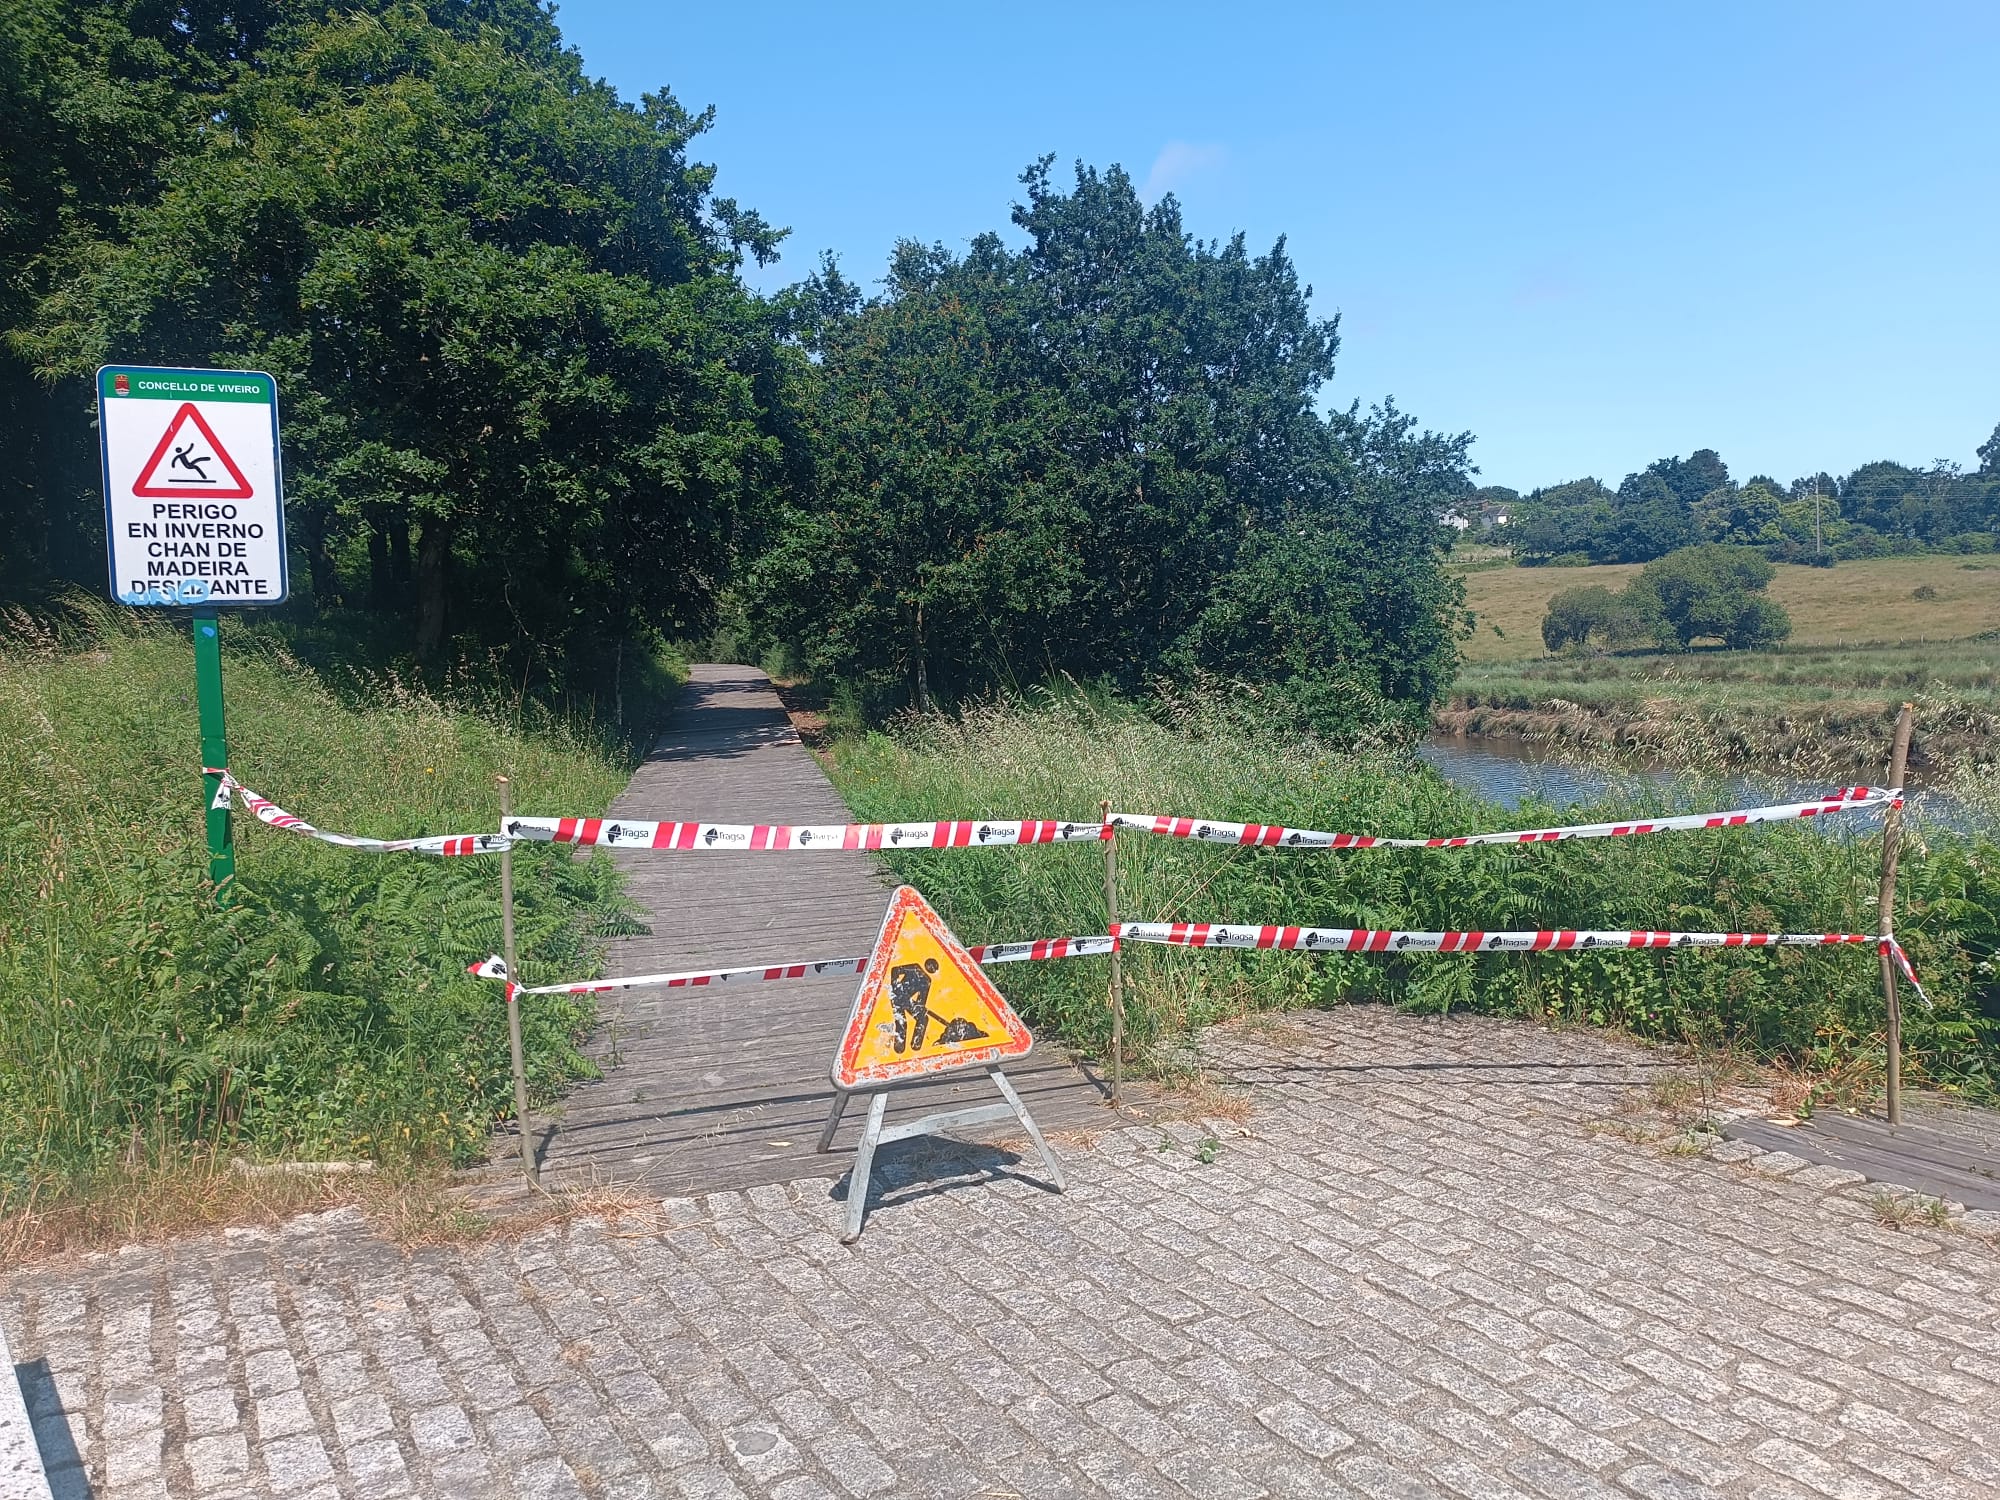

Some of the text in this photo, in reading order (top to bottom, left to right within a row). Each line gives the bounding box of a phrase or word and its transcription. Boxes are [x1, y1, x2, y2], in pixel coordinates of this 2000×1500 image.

[138, 381, 260, 394] CONCELLO DE VIVEIRO
[153, 504, 237, 520] PERIGO
[128, 523, 264, 539] EN INVERNO
[148, 542, 247, 557] CHAN DE
[147, 561, 249, 576] MADEIRA
[622, 827, 649, 839] Tragsa
[719, 831, 745, 842] Tragsa
[991, 827, 1015, 838] Tragsa
[1211, 827, 1236, 839] Tragsa
[1230, 932, 1254, 941] Tragsa
[1319, 935, 1344, 945] Tragsa
[1692, 937, 1719, 945] Tragsa
[1410, 938, 1436, 947] Tragsa
[1502, 939, 1529, 947] Tragsa
[1596, 939, 1623, 947] Tragsa
